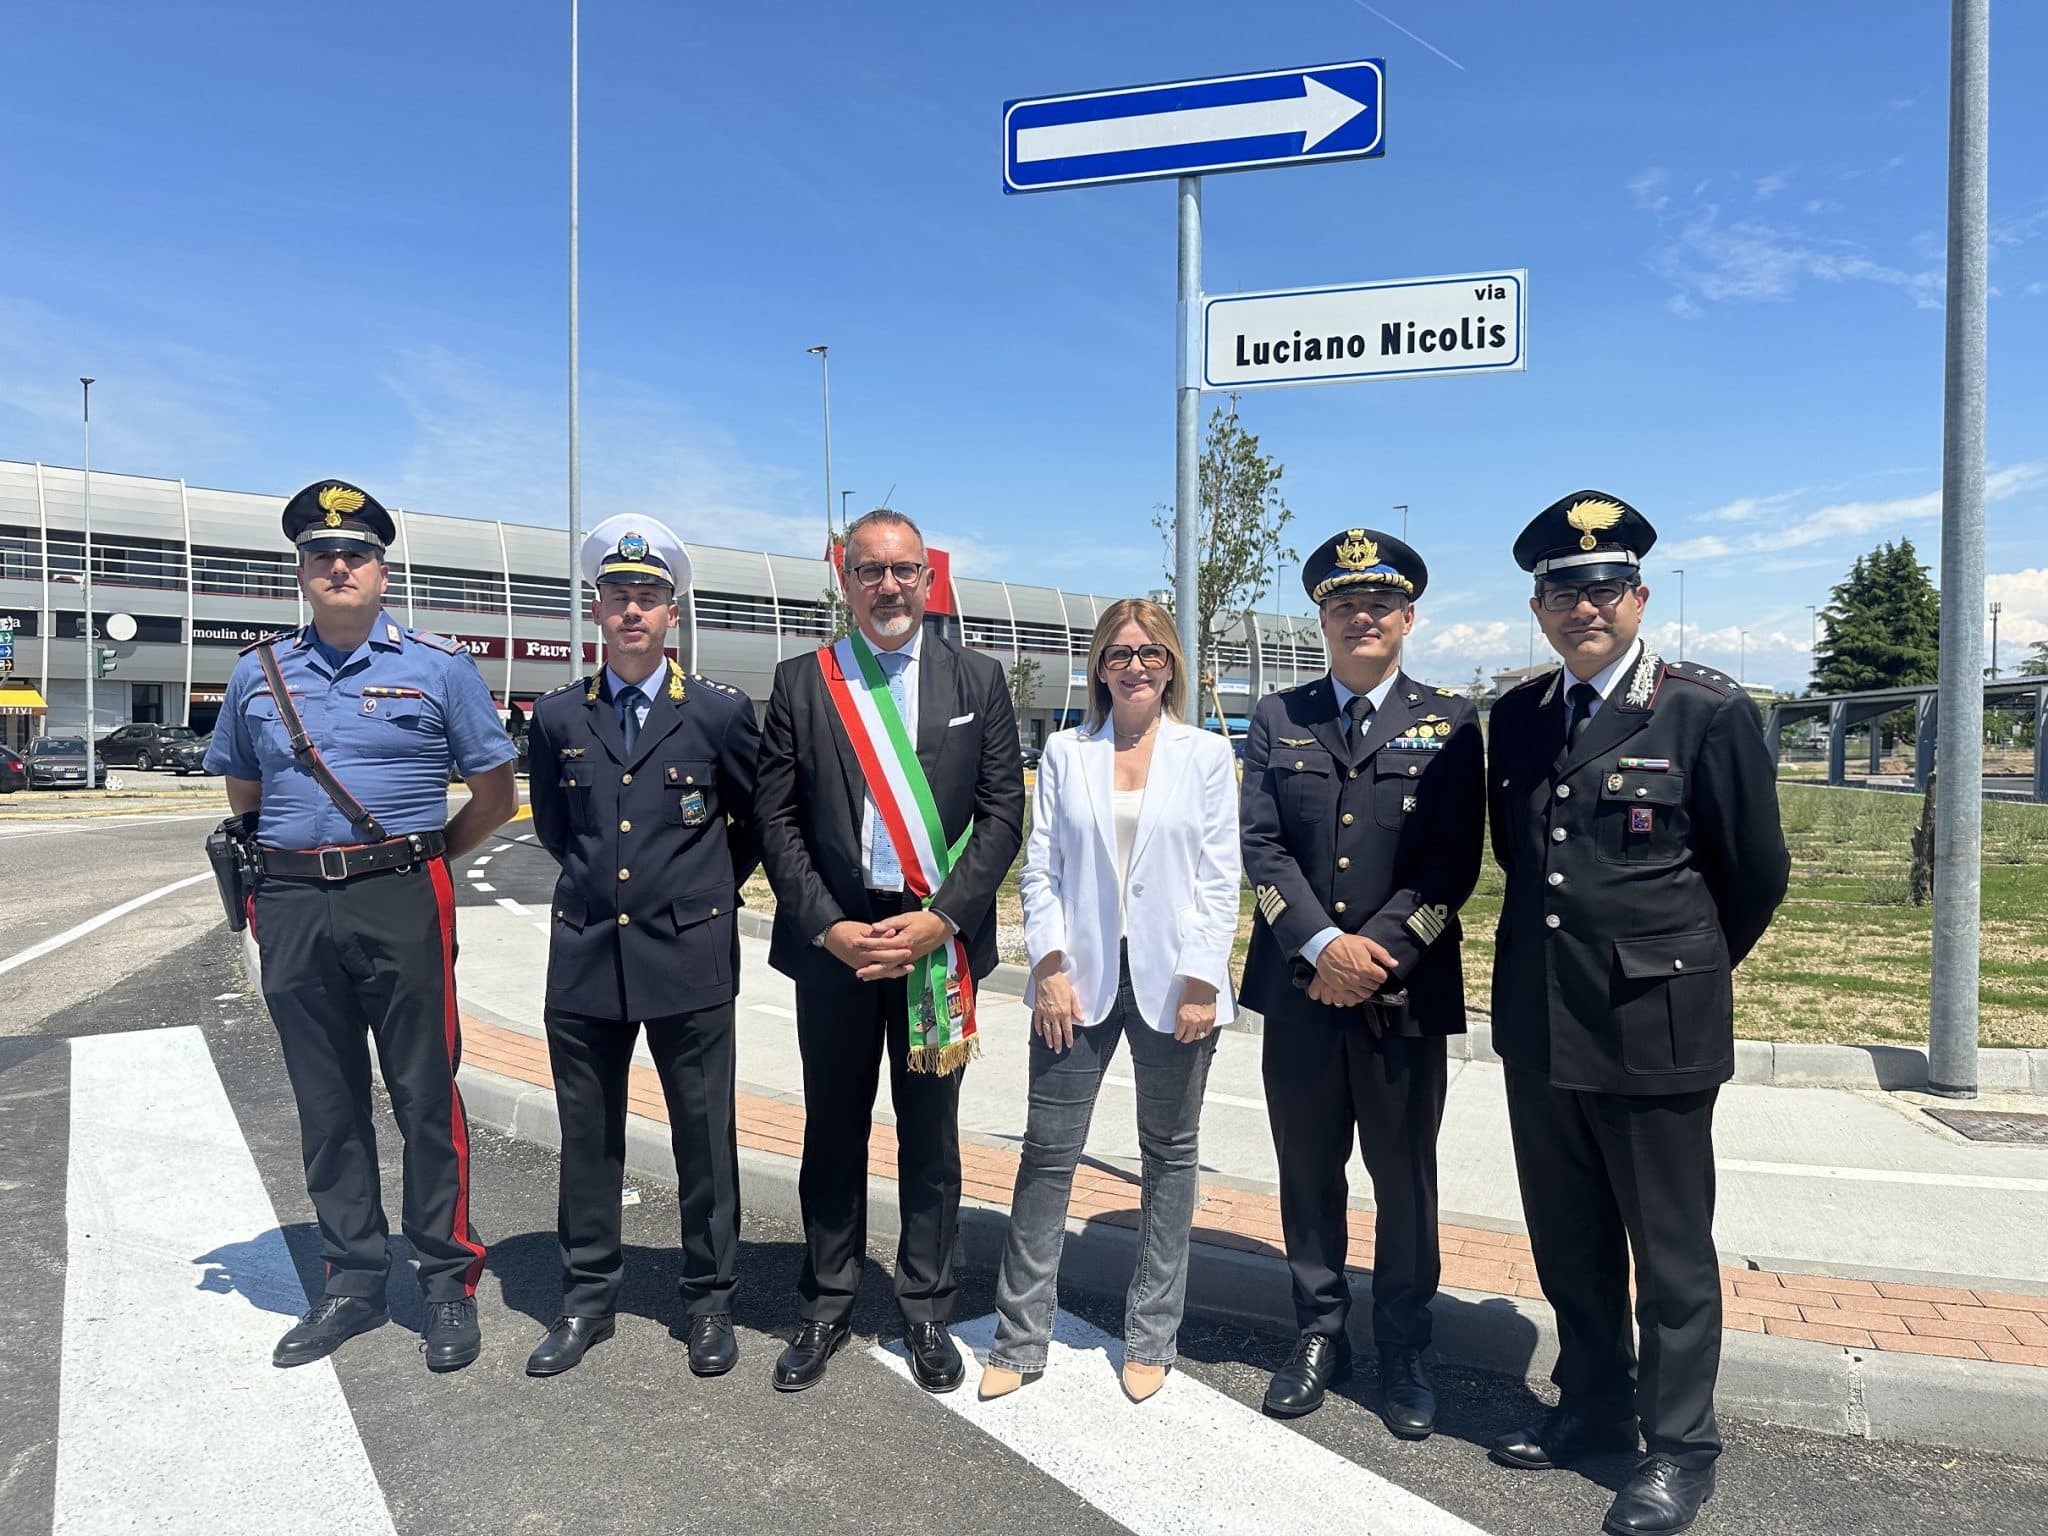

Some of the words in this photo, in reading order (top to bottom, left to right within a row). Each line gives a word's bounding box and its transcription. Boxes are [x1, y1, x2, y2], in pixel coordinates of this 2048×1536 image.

[1474, 284, 1507, 301] via
[1236, 330, 1366, 367] Luciano
[1381, 316, 1507, 356] Nicolis
[192, 628, 238, 640] moulin
[240, 629, 257, 640] de
